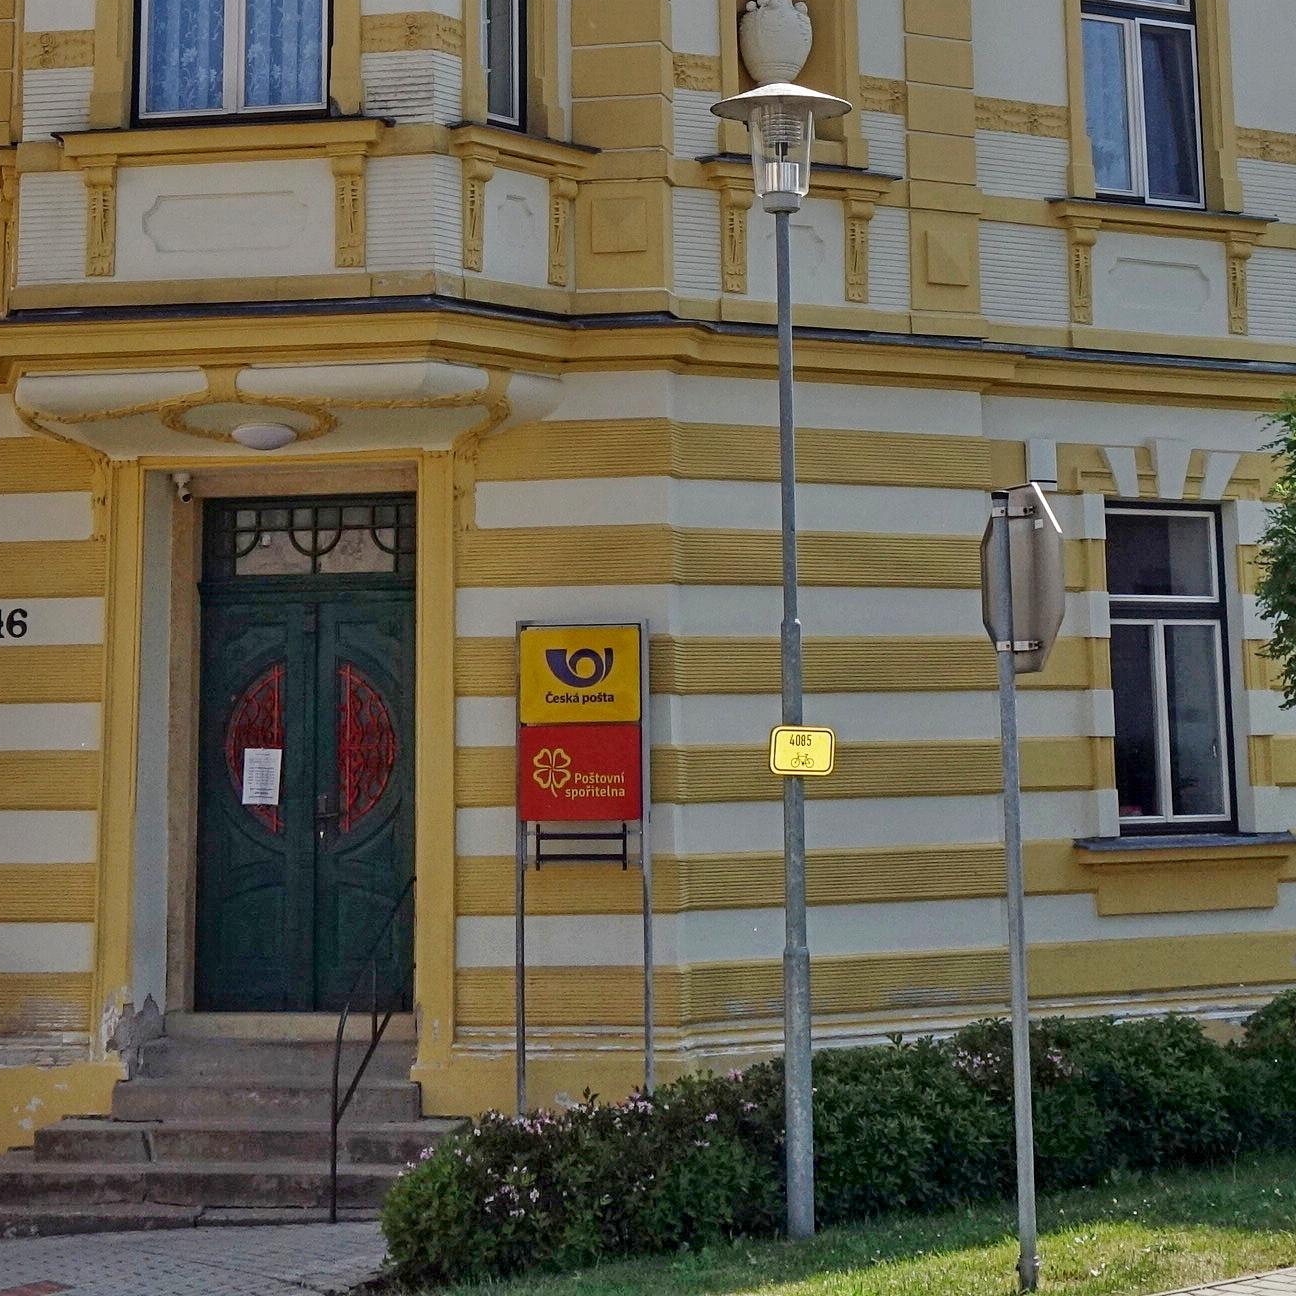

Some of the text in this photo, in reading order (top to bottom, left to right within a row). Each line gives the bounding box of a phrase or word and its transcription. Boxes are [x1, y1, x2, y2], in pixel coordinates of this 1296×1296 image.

[545, 691, 615, 705] Česká pošta
[789, 734, 812, 747] 4085
[574, 771, 625, 784] Poštovní
[565, 784, 625, 800] spořitelna
